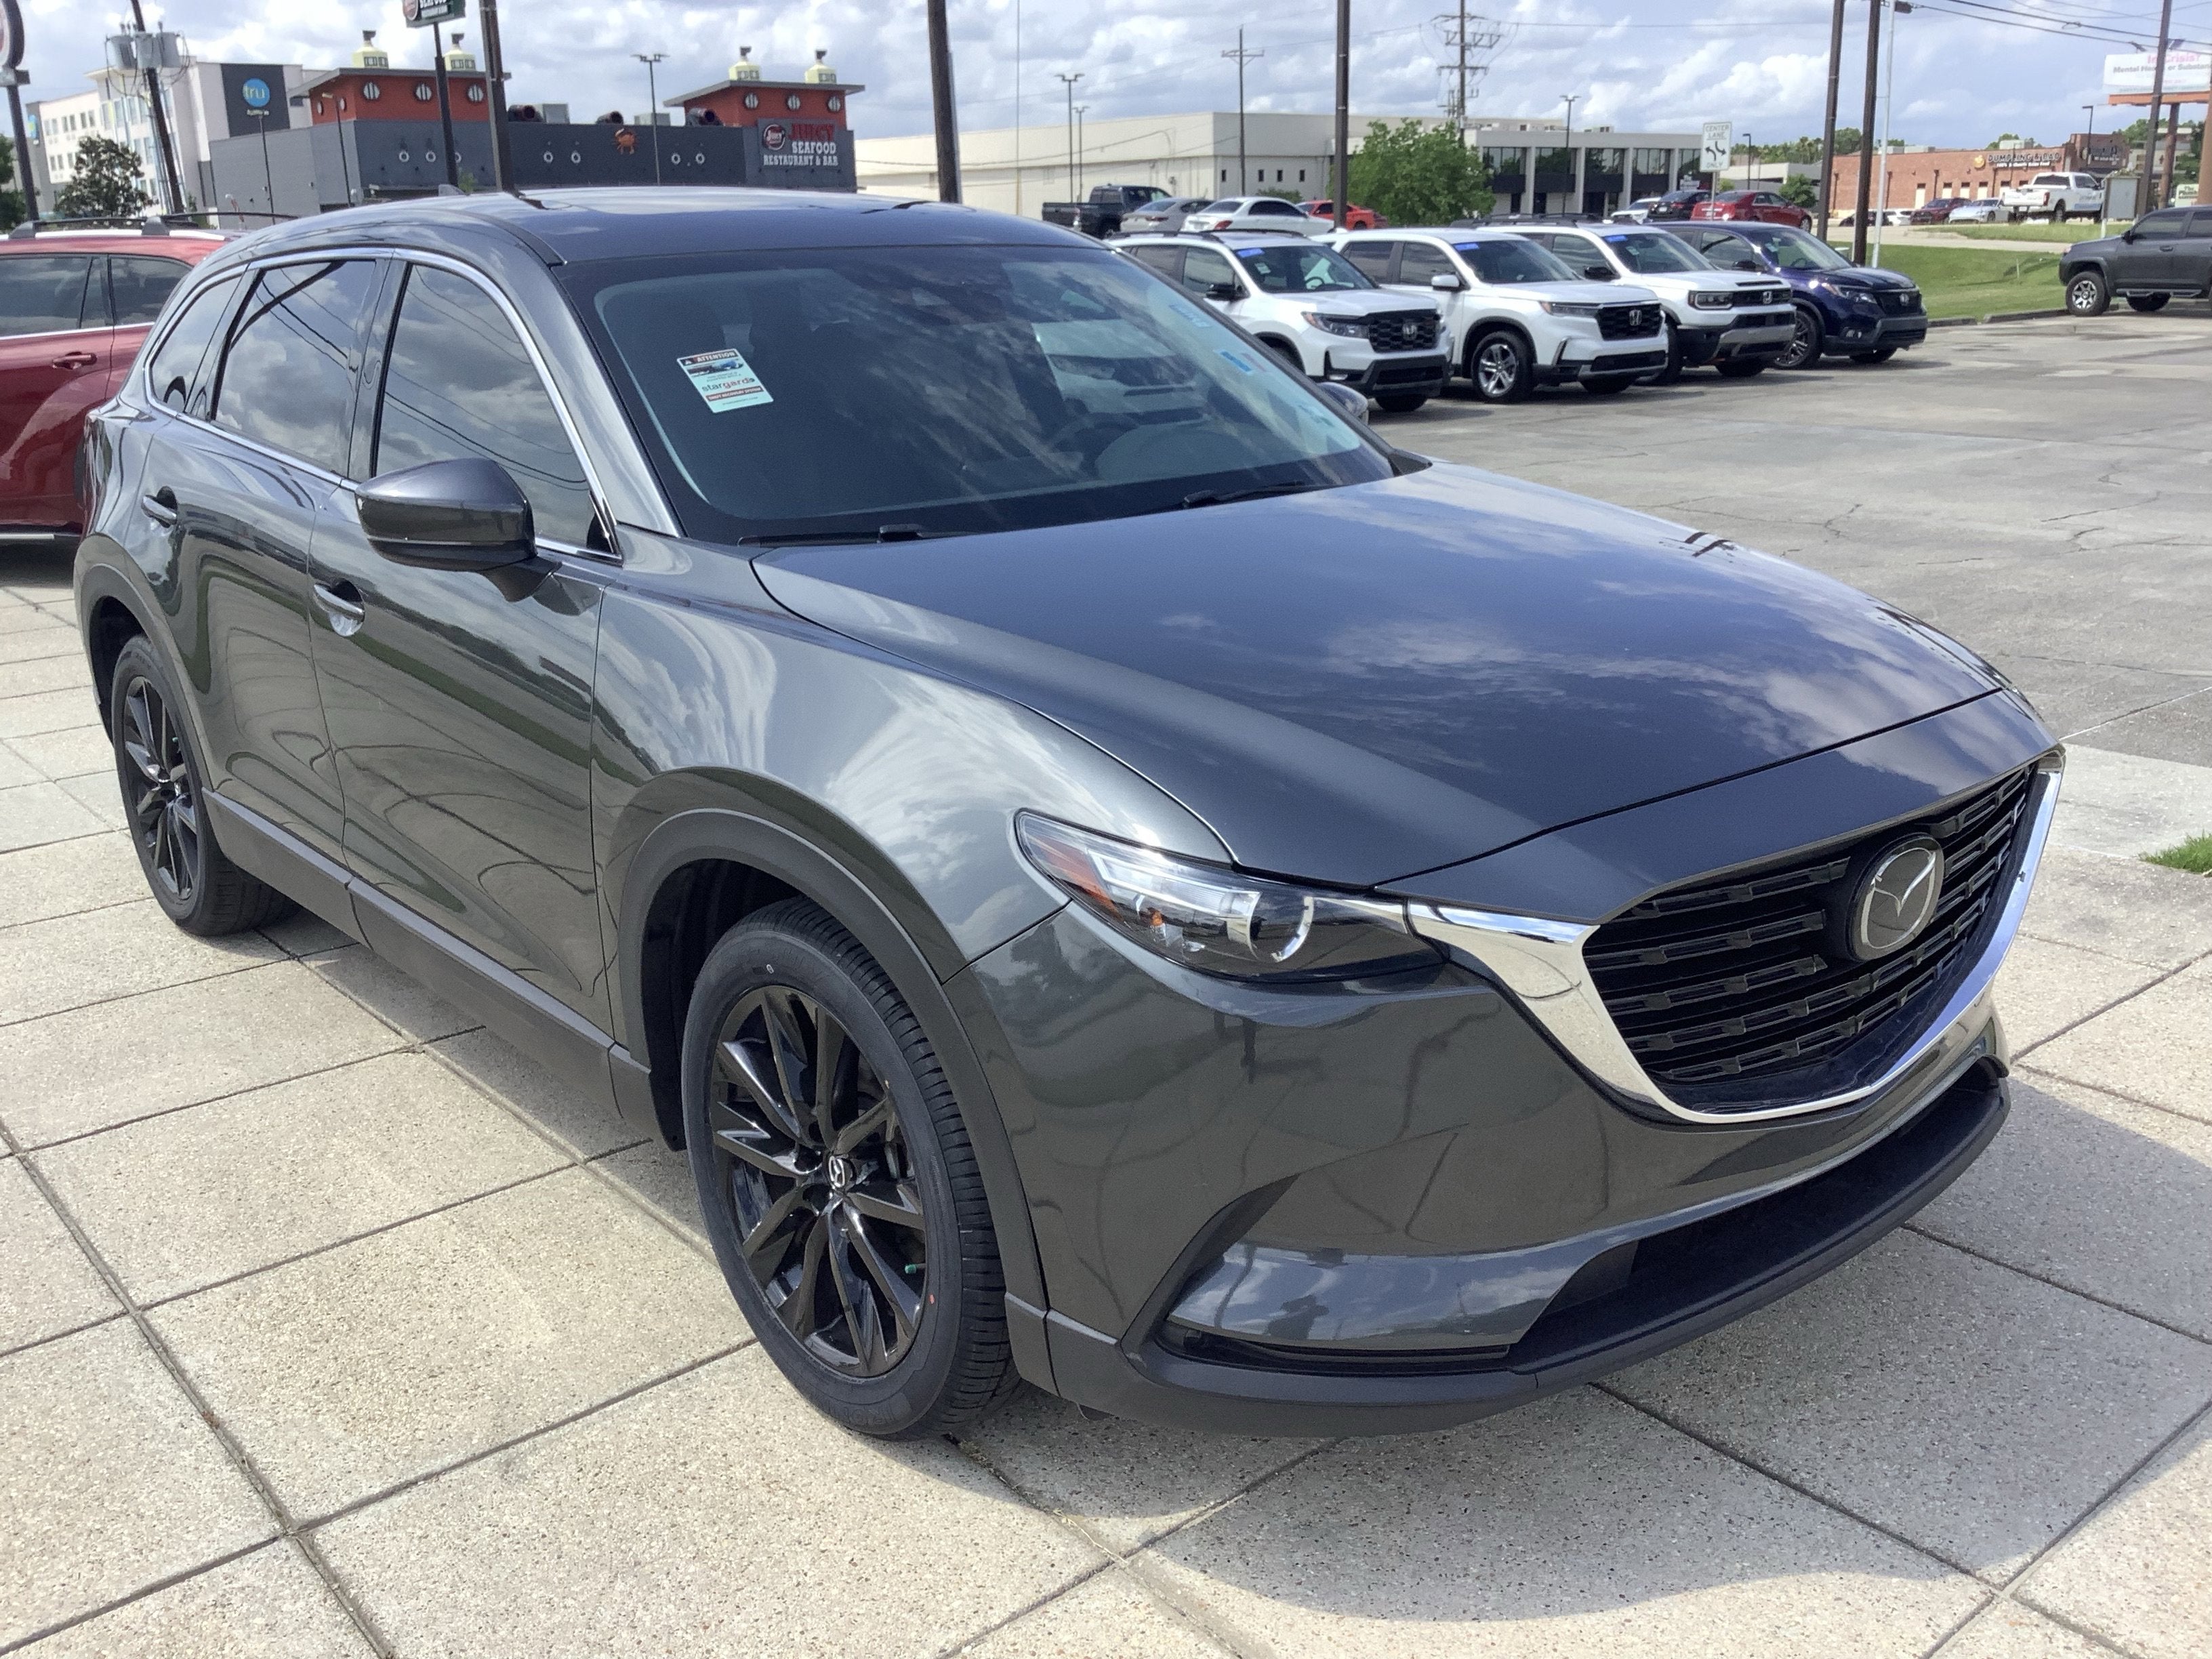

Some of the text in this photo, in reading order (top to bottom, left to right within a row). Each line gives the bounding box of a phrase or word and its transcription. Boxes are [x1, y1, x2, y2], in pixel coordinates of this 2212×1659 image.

[2113, 65, 2139, 73] Mental
[243, 85, 265, 98] tru
[792, 142, 836, 155] SEAFOOD
[763, 155, 839, 167] RESTAURANT & BAR
[697, 352, 735, 363] ATTENTION
